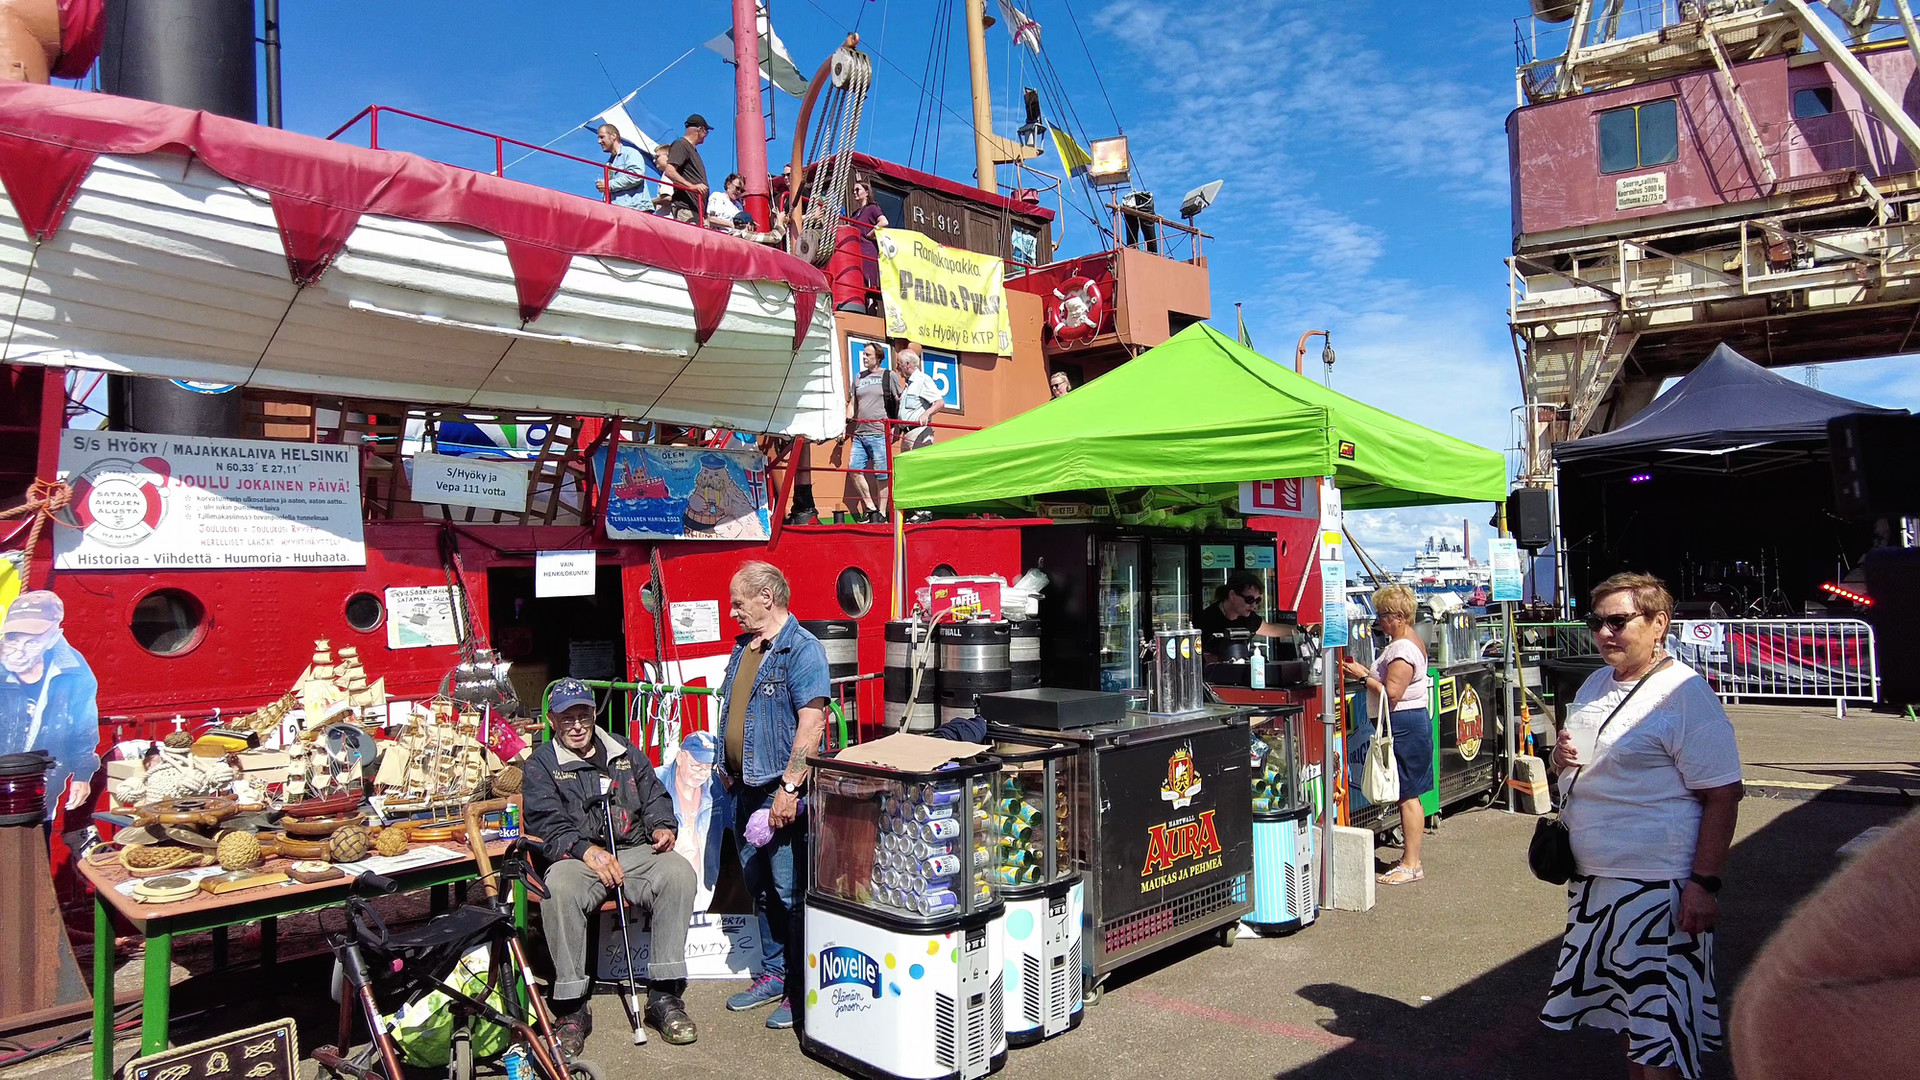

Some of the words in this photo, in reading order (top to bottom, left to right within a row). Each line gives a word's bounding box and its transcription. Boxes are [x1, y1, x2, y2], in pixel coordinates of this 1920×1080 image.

[1658, 184, 1664, 192] kg
[913, 206, 960, 236] R-1912
[914, 240, 981, 277] Rantakapakka
[950, 290, 960, 310] &
[932, 324, 960, 345] Hyöky
[962, 330, 969, 344] &
[971, 331, 994, 344] KTP
[932, 362, 950, 398] 5
[173, 444, 276, 460] MAJAKKALAIVA
[281, 448, 349, 463] HELSINKI
[216, 462, 223, 471] N
[175, 474, 230, 490] JOULU
[236, 478, 304, 491] JOKAINEN
[309, 478, 350, 493] PÄIVÄ!
[446, 468, 487, 482] S/Hyöky
[488, 473, 498, 483] ja
[436, 481, 460, 492] Vepa
[462, 484, 480, 494] 111
[482, 486, 506, 497] votta
[1327, 503, 1338, 517] WC
[78, 554, 140, 564] Historiaa
[153, 552, 212, 564] Viihdettä
[224, 552, 282, 564] Huumoria
[293, 552, 350, 562] Huuhaata.
[950, 592, 980, 604] TAFFEL
[1168, 814, 1196, 828] HARTWALL
[1141, 809, 1222, 876] AURA
[1140, 871, 1178, 894] MAUKAS
[1178, 868, 1189, 881] JA
[1190, 855, 1223, 878] PEHMEÄ
[716, 916, 746, 926] KERTA
[823, 952, 876, 984] Novelle
[831, 988, 864, 1005] Elämän
[835, 1003, 871, 1018] janoon
